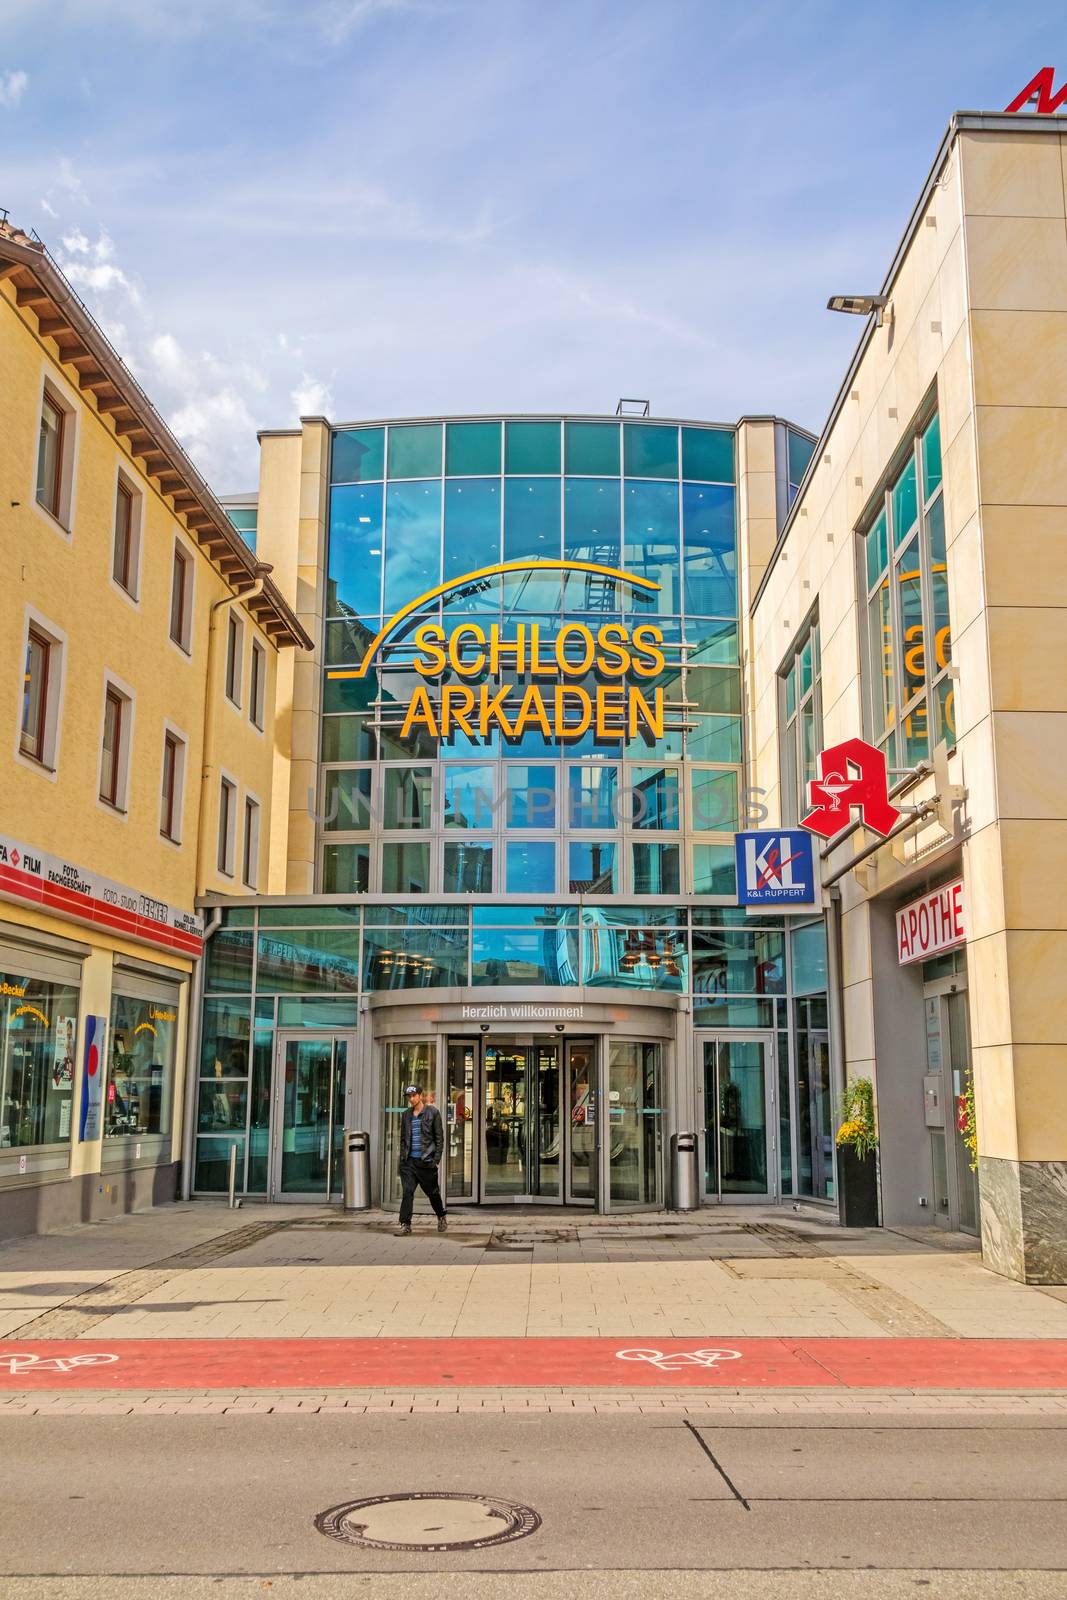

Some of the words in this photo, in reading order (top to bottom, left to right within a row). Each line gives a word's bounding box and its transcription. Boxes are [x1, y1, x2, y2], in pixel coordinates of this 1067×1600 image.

[413, 623, 666, 677] SCHLOSS
[400, 684, 666, 741] ARKADEN
[23, 854, 41, 874] FILM
[62, 864, 79, 879] FOTO-
[744, 837, 806, 890] K&L
[48, 870, 92, 895] FACHGESCHÄFT
[747, 890, 763, 898] K&L
[765, 889, 805, 897] RUPPERT
[103, 888, 118, 904] FOTO
[139, 894, 169, 924] BECKER
[462, 1004, 507, 1018] Herzlich
[510, 1004, 584, 1018] willkommen!
